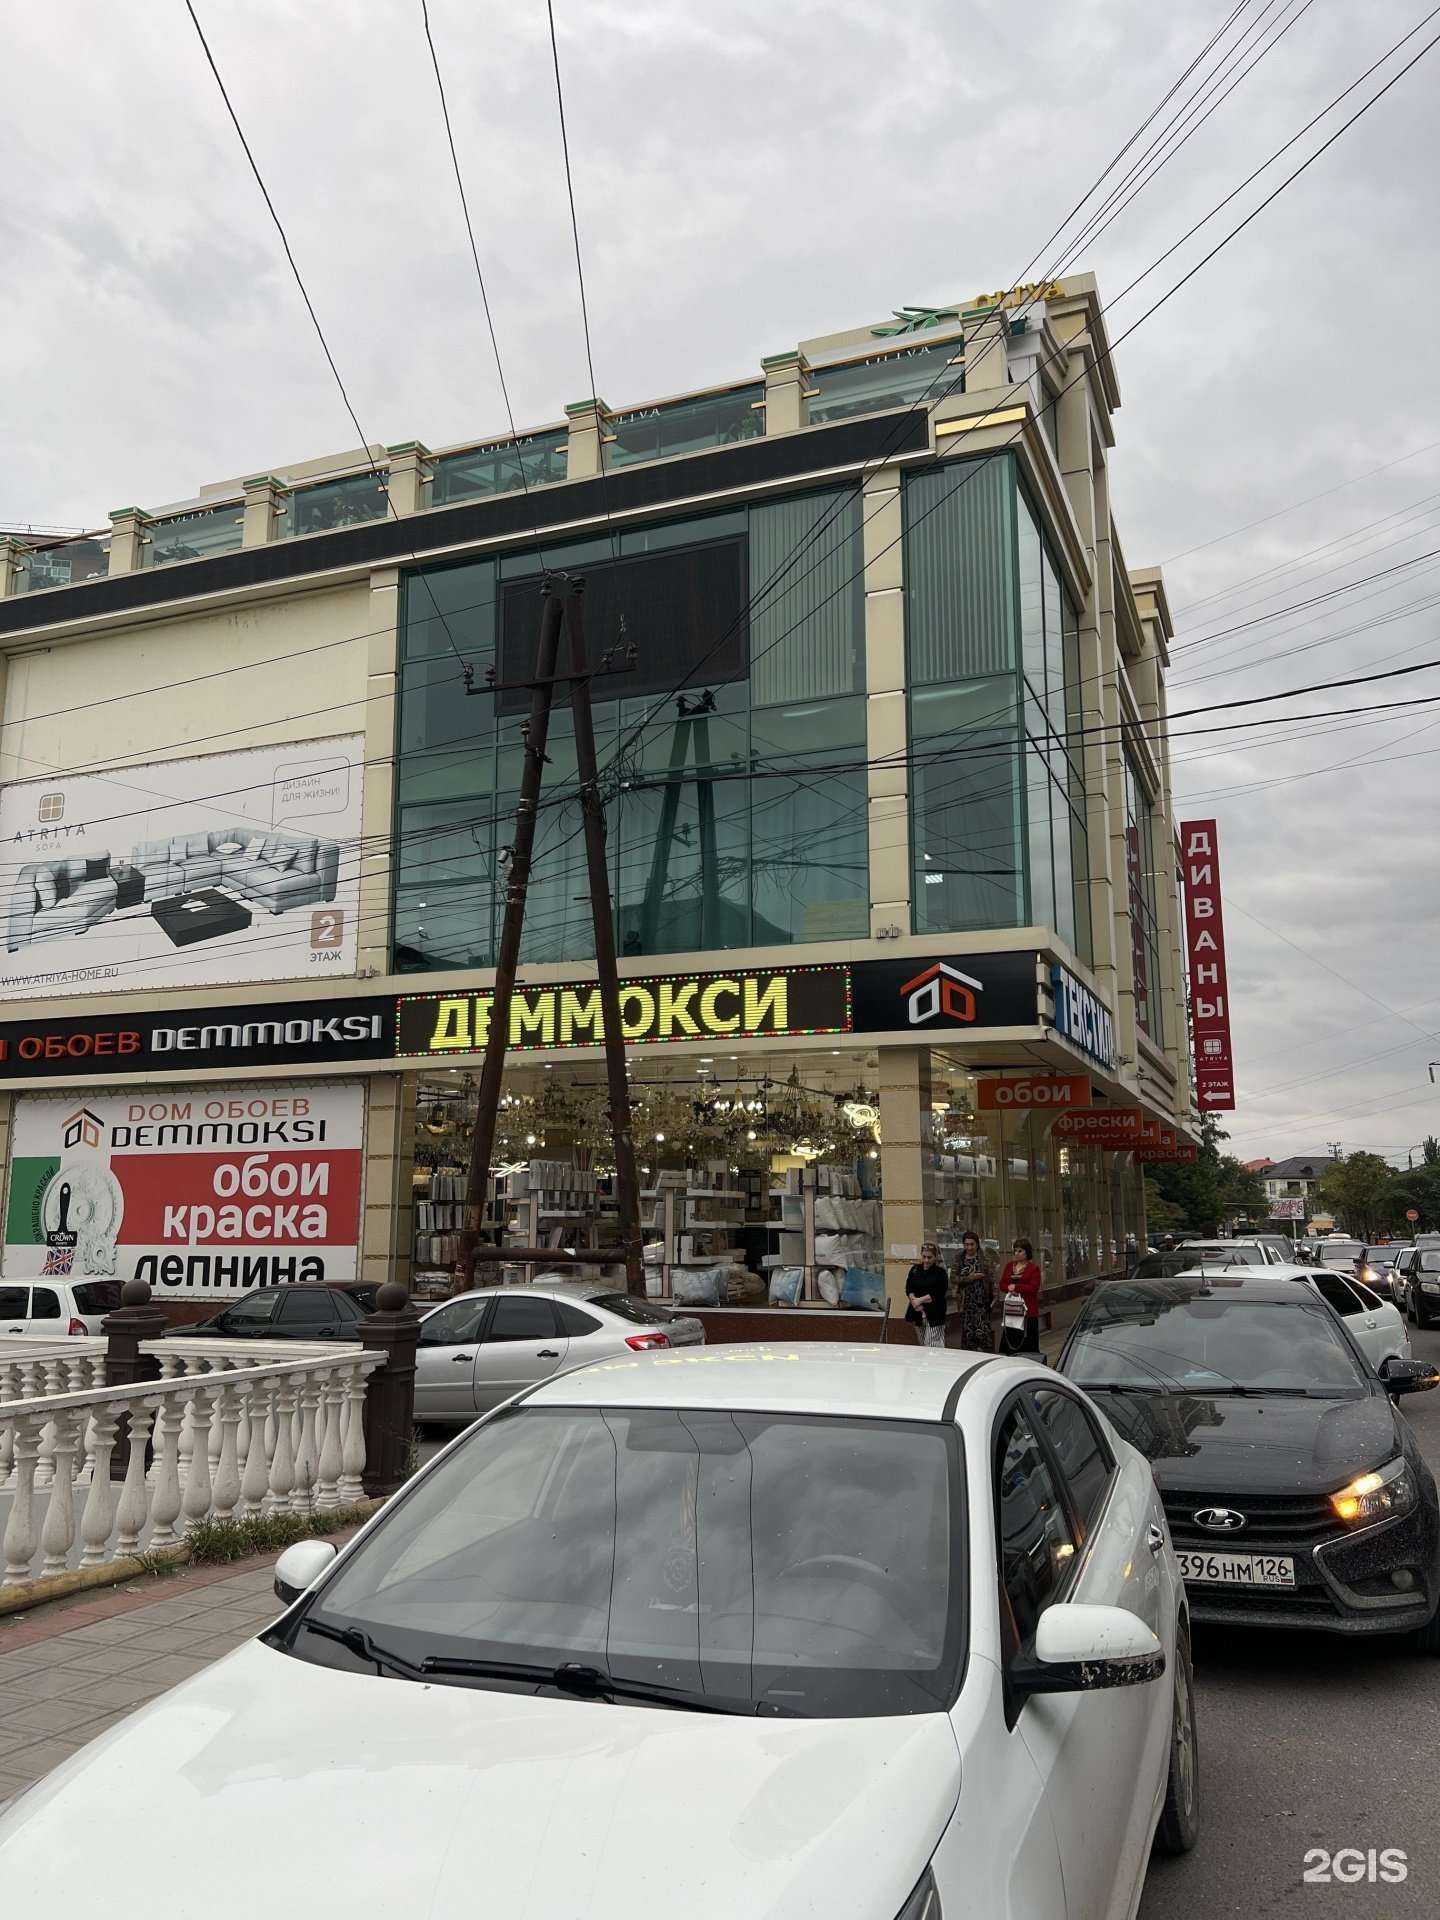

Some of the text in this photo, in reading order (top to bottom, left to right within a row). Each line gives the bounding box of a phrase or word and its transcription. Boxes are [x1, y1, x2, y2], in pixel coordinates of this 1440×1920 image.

[282, 777, 321, 790] ДИЗАЙН
[281, 791, 301, 803] ДЛЯ
[13, 825, 86, 843] ATRIYA
[318, 915, 336, 942] 2
[1188, 832, 1224, 1018] ДИВАНЫ
[310, 951, 342, 962] ЭТАЖ
[430, 977, 788, 1050] ДЕММОКСИ
[18, 1031, 141, 1059] ОБОЕВ
[996, 1081, 1072, 1103] обои
[204, 1098, 310, 1119] ОБОЕВ
[1057, 1115, 1136, 1131] фрески
[213, 1154, 329, 1197] обои
[163, 1204, 327, 1245] краска
[134, 1255, 325, 1287] лепнина
[1255, 1558, 1288, 1577] 126
